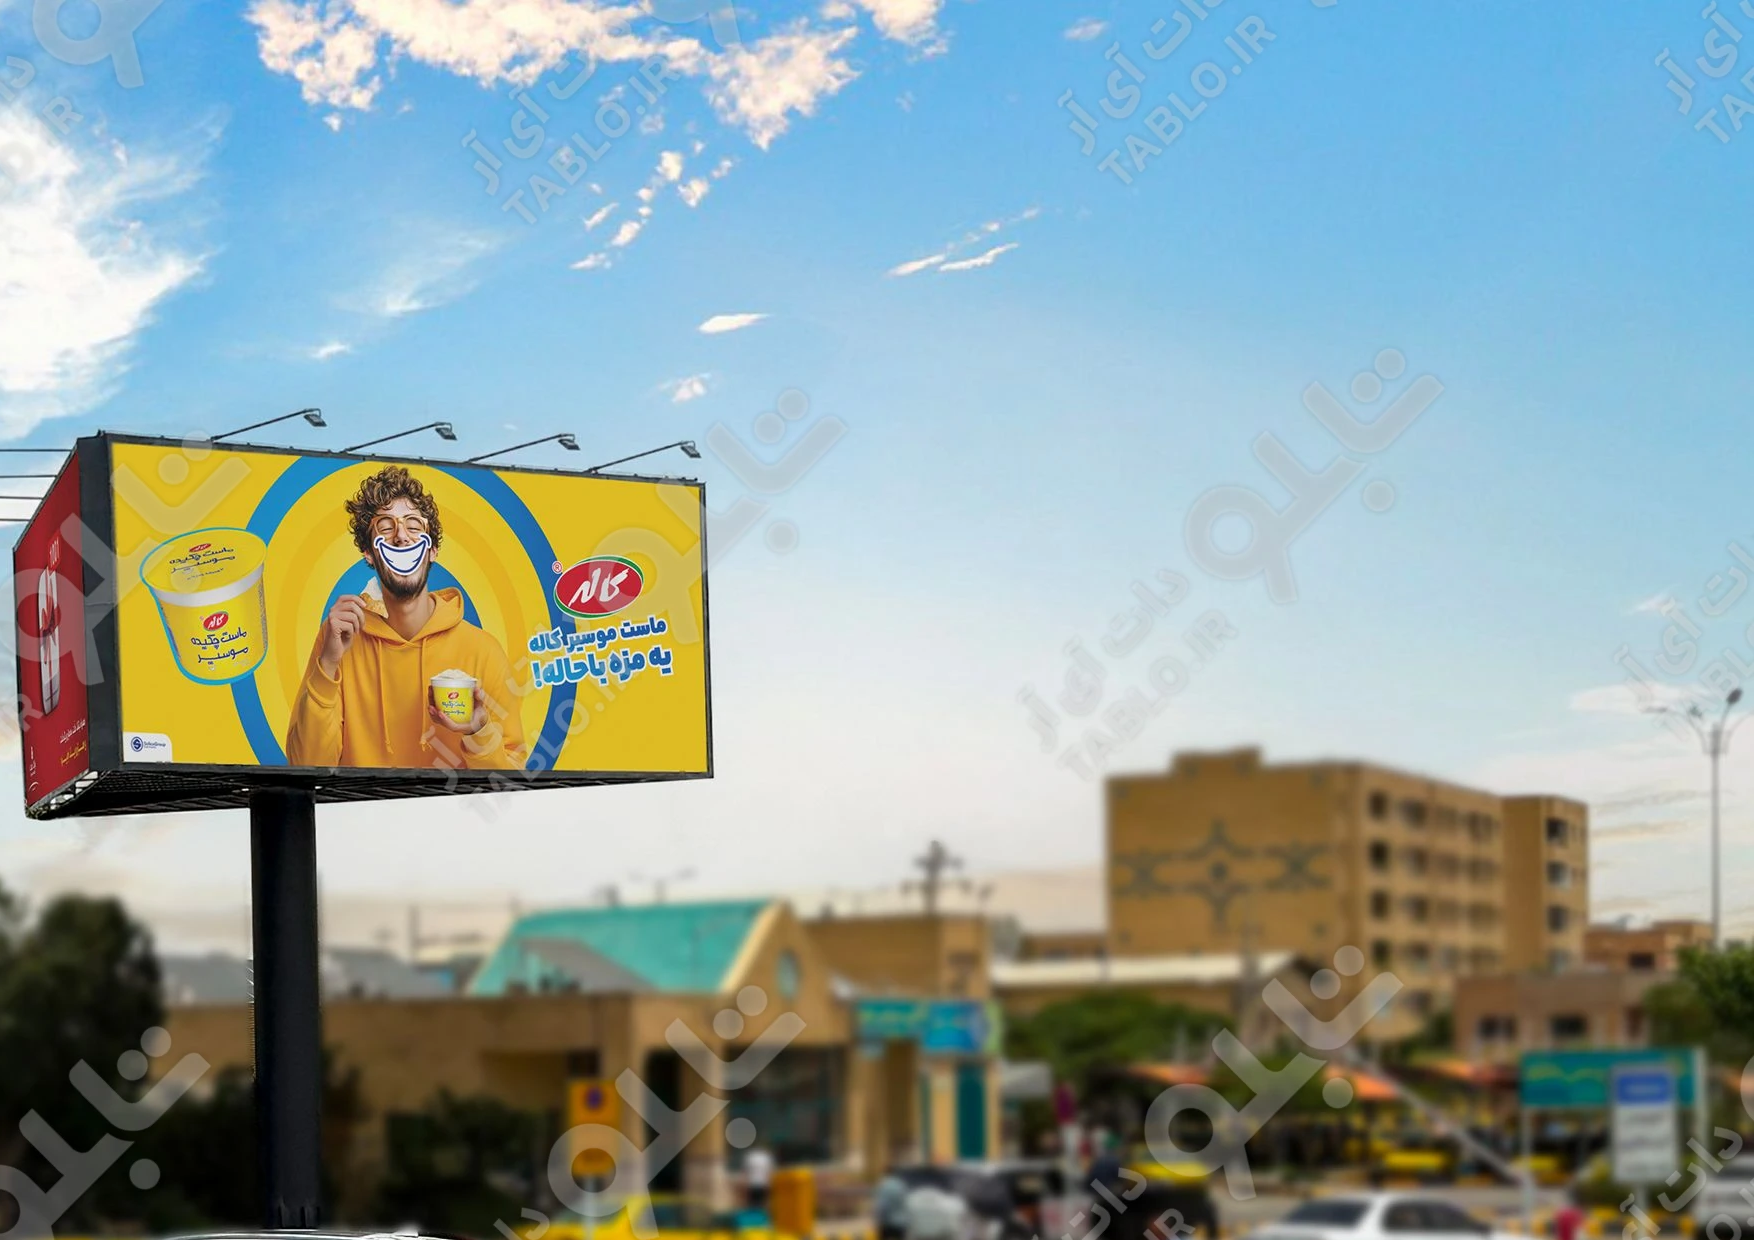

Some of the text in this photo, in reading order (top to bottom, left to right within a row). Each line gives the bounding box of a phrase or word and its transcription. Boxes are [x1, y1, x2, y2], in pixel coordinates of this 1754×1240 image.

[190, 626, 248, 650] ماست چکیده
[529, 615, 667, 653] ماست موسیر کاله
[197, 646, 249, 665] موسیر
[609, 648, 646, 683] مزه
[648, 645, 674, 677] یه
